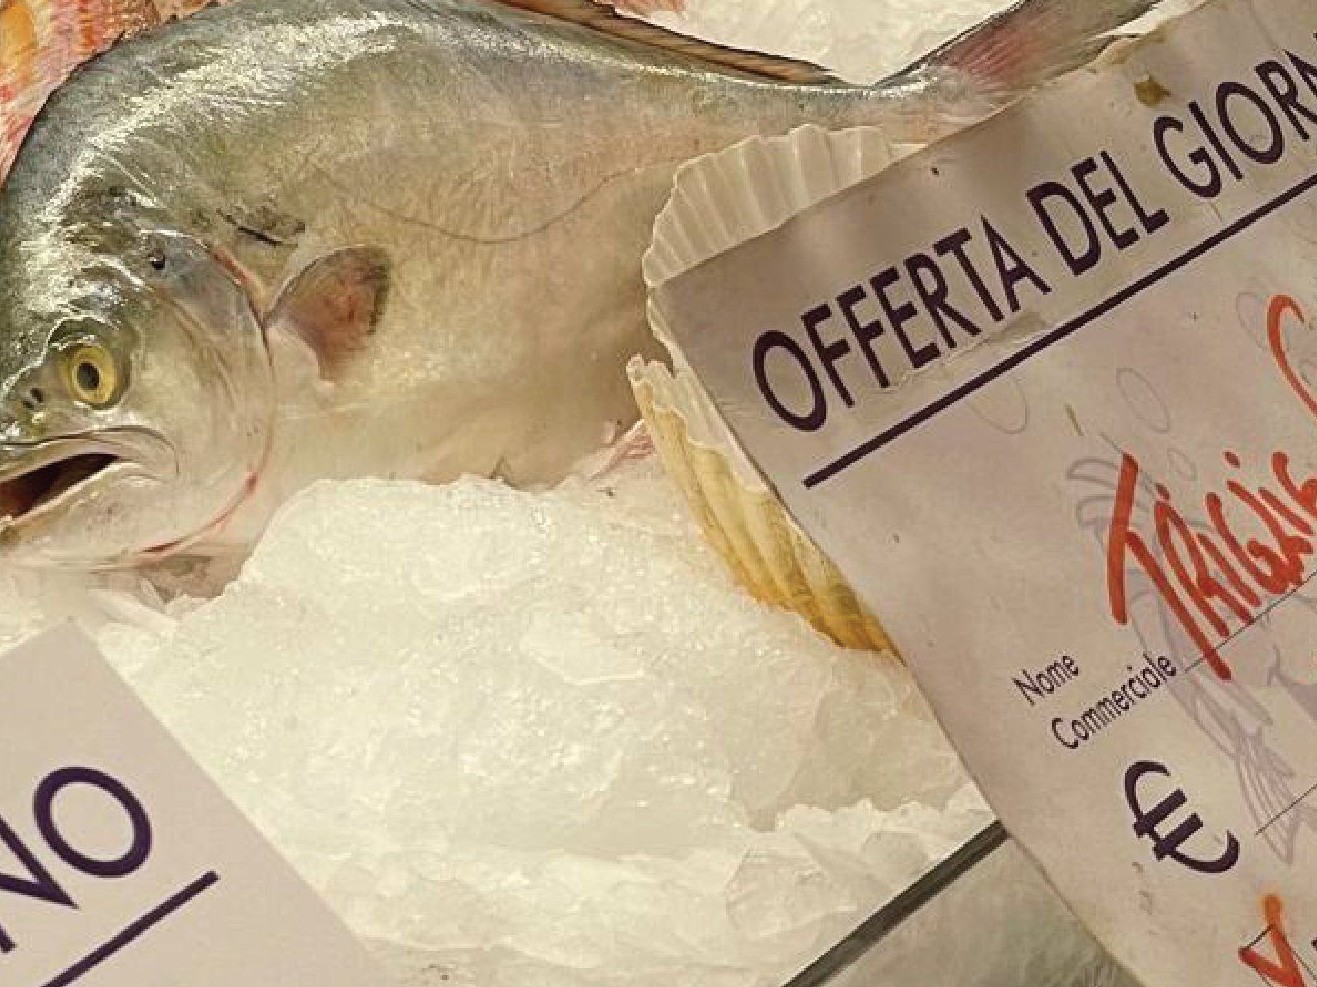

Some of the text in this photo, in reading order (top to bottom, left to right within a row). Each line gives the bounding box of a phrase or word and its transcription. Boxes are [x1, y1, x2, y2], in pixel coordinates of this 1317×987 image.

[752, 214, 1052, 432] OFFERTA
[1027, 150, 1169, 277] DEL
[1013, 653, 1081, 706] Nome
[1050, 652, 1178, 750] Commerciale
[1124, 760, 1240, 874] €
